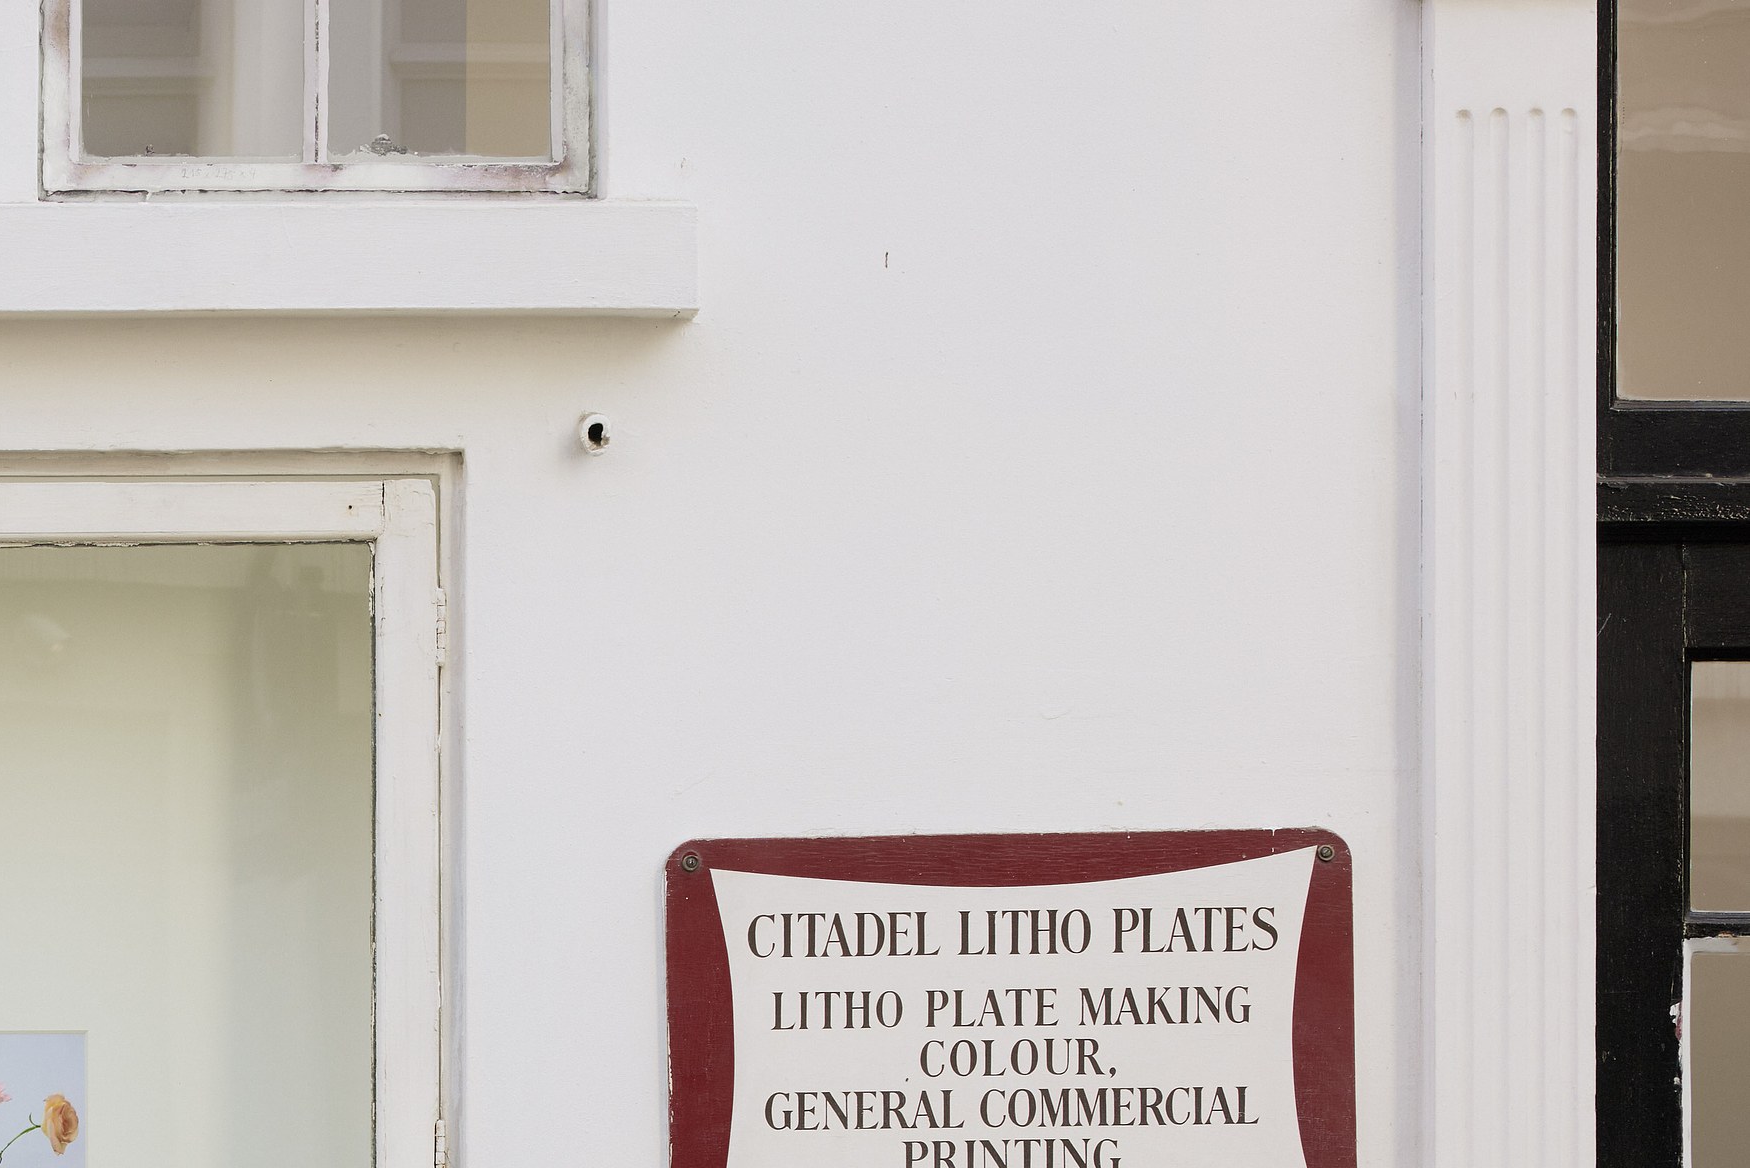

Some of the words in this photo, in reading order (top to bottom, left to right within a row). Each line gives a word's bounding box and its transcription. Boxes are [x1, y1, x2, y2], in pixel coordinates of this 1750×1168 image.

[747, 911, 941, 959] CITADEL
[957, 908, 1092, 956] LITHO
[1112, 906, 1279, 954] PLATES
[770, 990, 903, 1031] LITHO
[925, 988, 1059, 1028] PLATE
[1078, 985, 1252, 1026] MAKING
[919, 1038, 1117, 1078] COLOUR,
[764, 1089, 965, 1131] GENERAL
[979, 1086, 1260, 1128] COMMERCIAL
